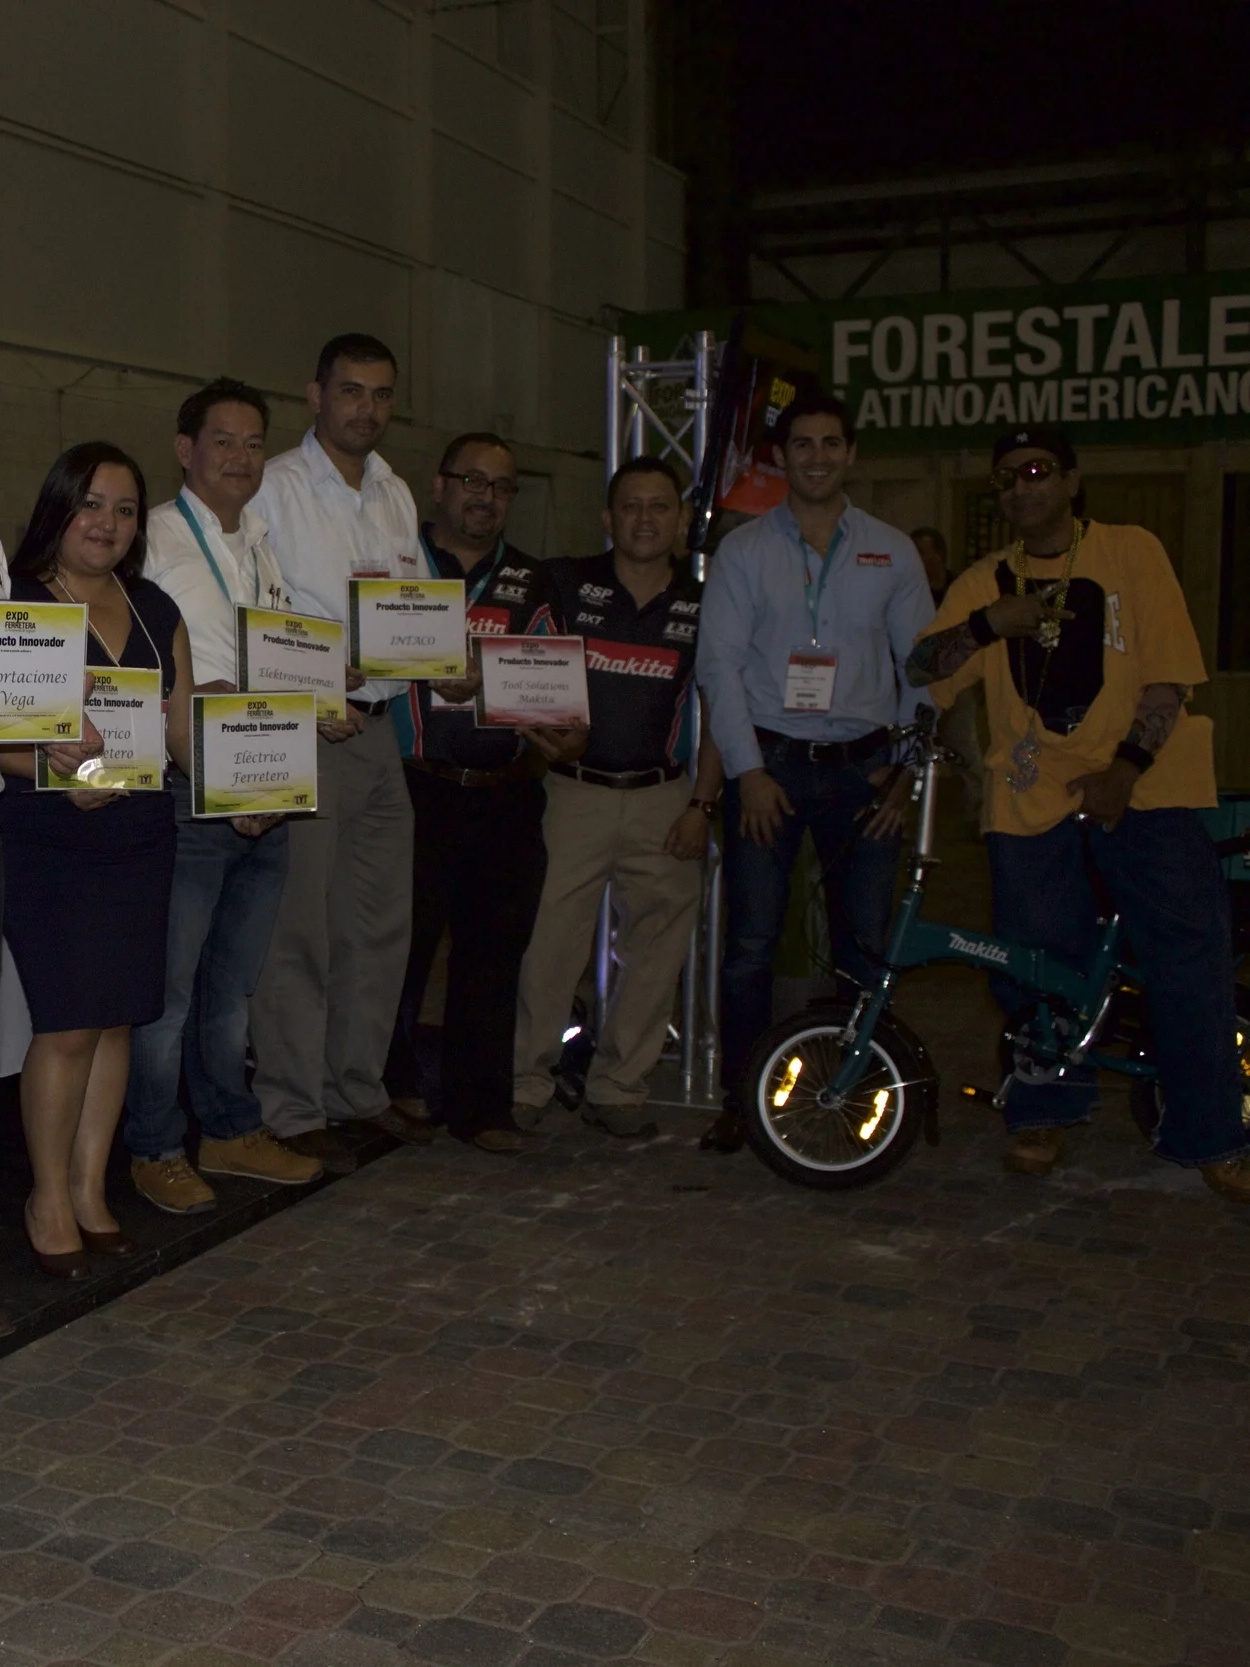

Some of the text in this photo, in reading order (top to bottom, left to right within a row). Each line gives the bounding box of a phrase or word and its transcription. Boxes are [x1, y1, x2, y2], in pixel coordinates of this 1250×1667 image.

[579, 582, 614, 600] SSP
[376, 602, 449, 611] Producto Innovador
[5, 610, 29, 623] expo
[576, 612, 606, 625] DXT
[4, 622, 36, 630] FERRETERA
[285, 620, 303, 629] expo
[19, 636, 65, 648] Innovador
[263, 634, 331, 653] Producto Innovador
[533, 658, 569, 666] Innovador
[586, 650, 675, 680] Makita
[0, 690, 35, 711] Vega
[104, 698, 144, 708] Innovador
[247, 701, 267, 711] expo
[222, 722, 299, 733] Producto Innovador
[233, 750, 287, 765] Eléctrico
[231, 771, 290, 787] Ferretero
[948, 932, 1009, 965] Makita
